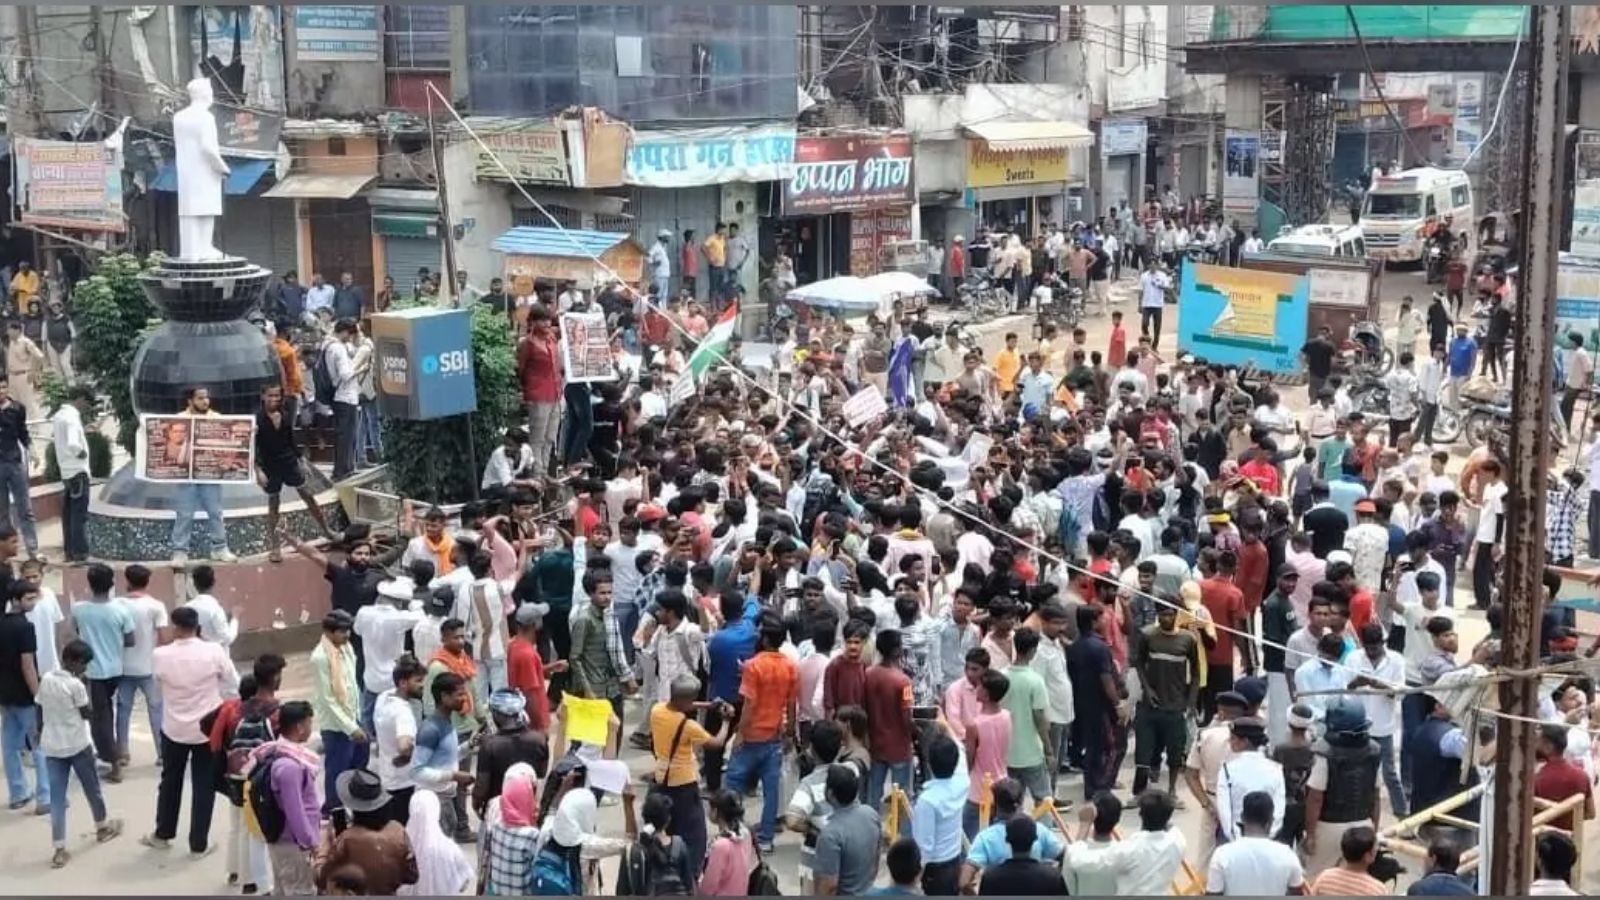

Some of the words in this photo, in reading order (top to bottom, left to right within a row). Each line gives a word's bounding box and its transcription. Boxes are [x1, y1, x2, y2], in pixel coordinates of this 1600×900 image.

[790, 160, 859, 196] छप्पन
[862, 146, 913, 190] भोग
[1006, 168, 1035, 182] Sweets
[383, 356, 407, 370] yono
[439, 350, 469, 373] SBI
